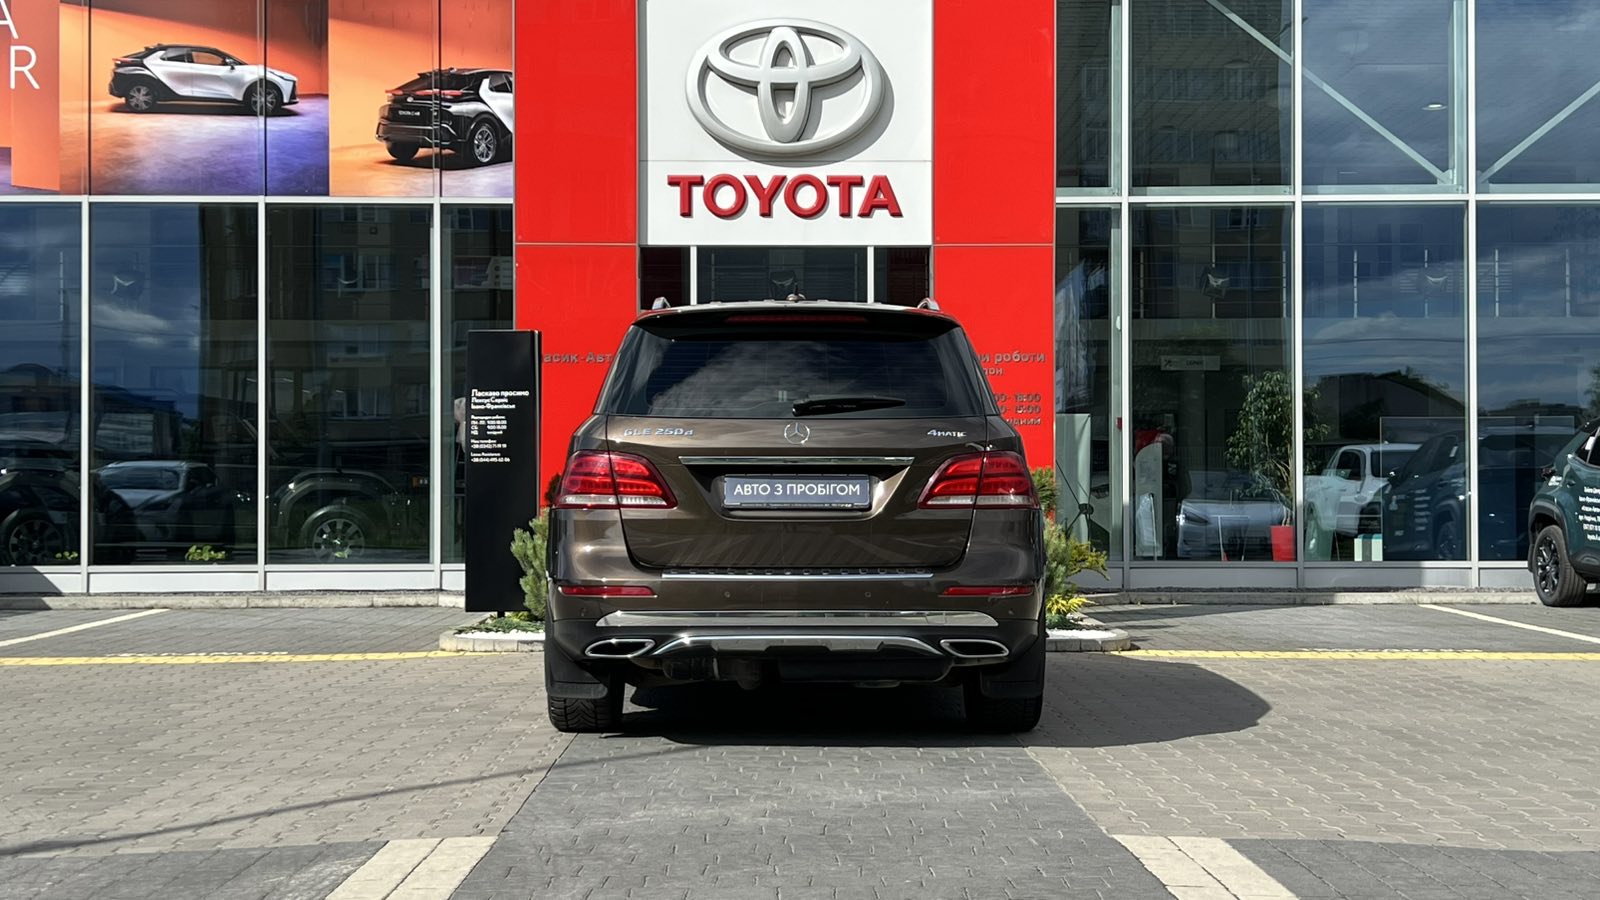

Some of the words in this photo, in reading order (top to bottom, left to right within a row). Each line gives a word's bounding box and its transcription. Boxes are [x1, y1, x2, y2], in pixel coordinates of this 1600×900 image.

[10, 46, 40, 89] R
[667, 174, 903, 219] TOYOTA
[995, 351, 1045, 364] роботи
[471, 389, 500, 397] Ласкаво
[624, 428, 651, 436] GLE
[927, 429, 967, 437] 4MATIC
[734, 484, 770, 496] АВТО
[774, 484, 783, 496] З
[787, 484, 860, 496] ПРОБІГОМ
